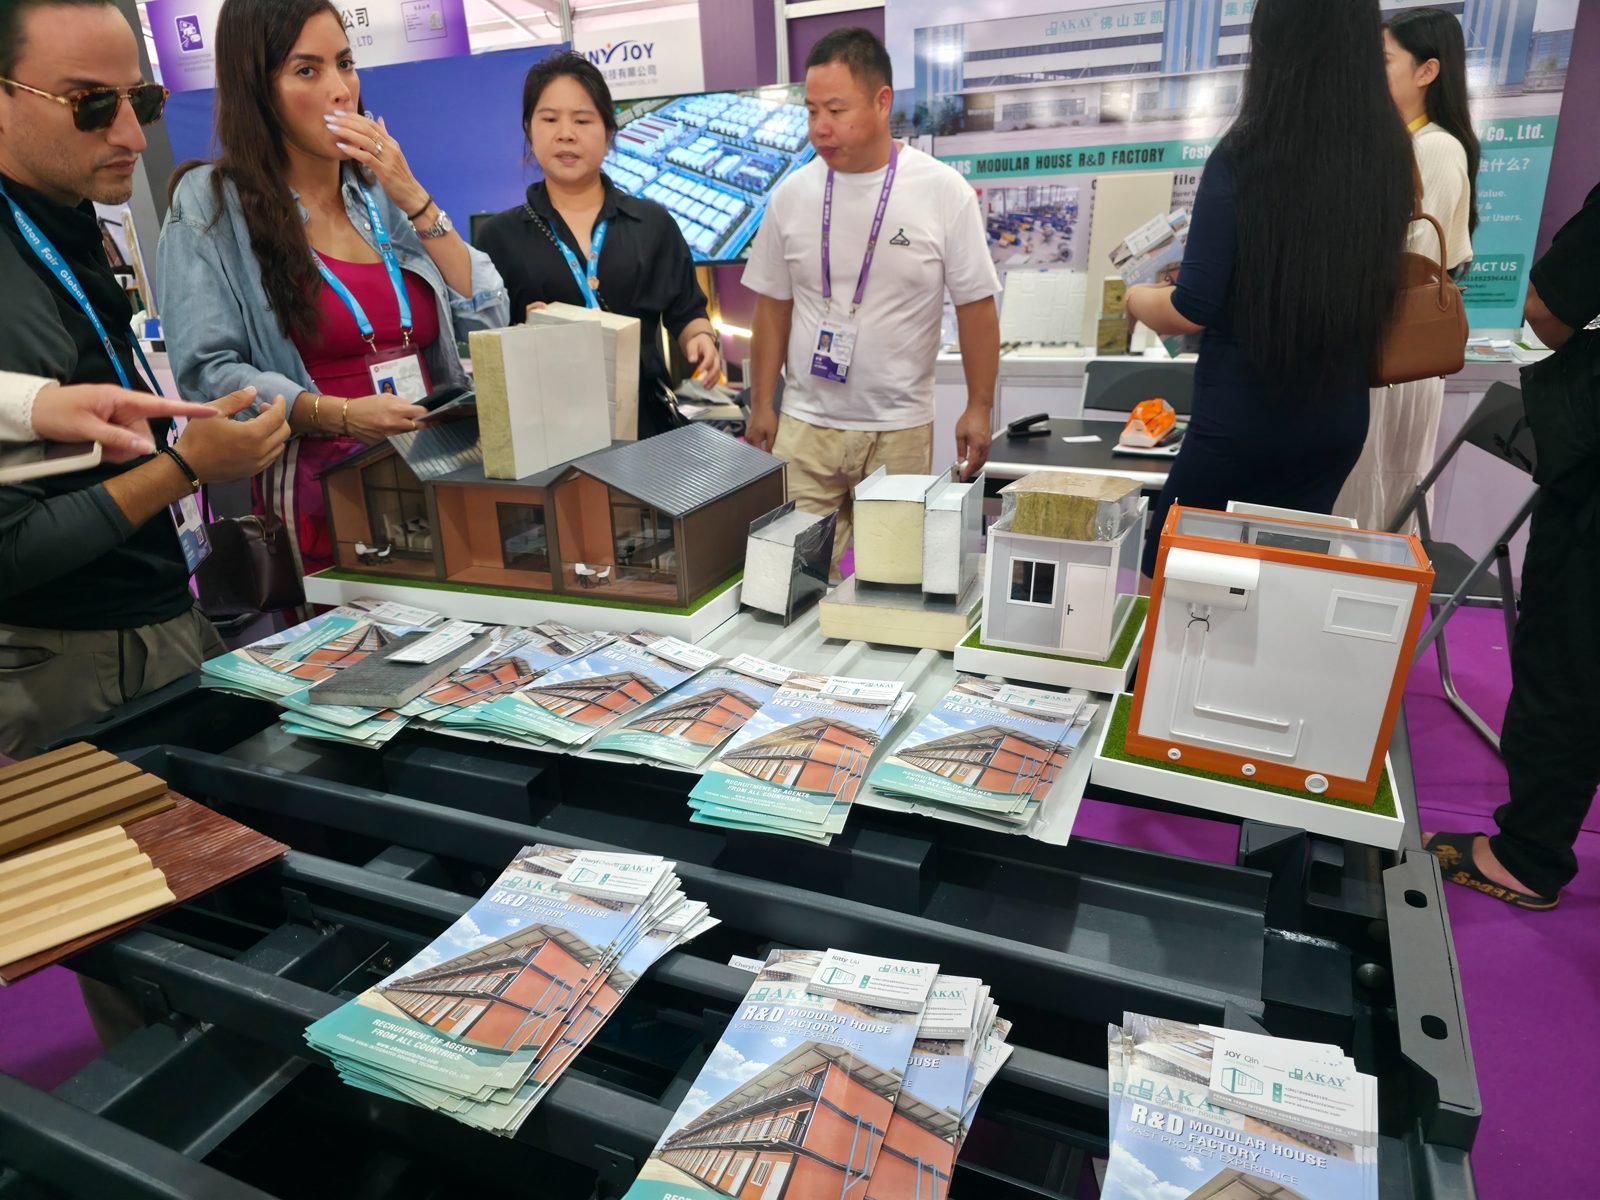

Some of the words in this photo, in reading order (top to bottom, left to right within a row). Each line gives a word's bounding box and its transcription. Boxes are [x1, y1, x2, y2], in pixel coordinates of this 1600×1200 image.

[342, 7, 369, 28] 公司
[622, 42, 654, 62] JOY
[1487, 126, 1513, 142] Co.,
[1517, 123, 1545, 140] Ltd.
[976, 156, 1030, 173] MODULAR
[1036, 153, 1072, 169] HOUSE
[1079, 151, 1105, 167] R&D
[1112, 147, 1165, 165] FACTORY
[15, 210, 41, 245] Canton
[41, 247, 59, 267] Fair
[60, 269, 84, 300] Global
[1500, 261, 1517, 272] US
[944, 701, 975, 714] R&D
[490, 890, 528, 906] R&D
[528, 897, 577, 912] MODULAR
[577, 907, 610, 919] HOUSE
[521, 905, 568, 918] FACTORY
[831, 955, 849, 963] Kitty
[890, 965, 923, 975] AKAY
[929, 989, 962, 998] AKAY
[741, 1004, 786, 1023] R&D
[787, 1008, 848, 1026] MODULAR
[850, 1019, 893, 1035] HOUSE
[783, 1018, 840, 1036] FACTORY
[370, 1028, 397, 1041] FROM
[396, 1036, 412, 1046] ALL
[414, 1041, 462, 1061] COUNTRIES
[371, 1018, 431, 1041] RECRUITMENT
[431, 1036, 445, 1046] OF
[443, 1040, 478, 1056] AGENTS
[803, 1031, 865, 1051] EXPERIENCE
[1223, 1049, 1241, 1059] JOY
[1244, 1055, 1260, 1065] Qin
[1304, 1071, 1346, 1088] AKAY
[1130, 1102, 1185, 1136] R&D
[1189, 1119, 1267, 1151] MODULAR
[1272, 1143, 1328, 1169] HOUSE
[1126, 1124, 1158, 1139] VAST
[1160, 1134, 1216, 1159] PROJECT
[1220, 1154, 1299, 1185] EXPERIENCE
[1188, 1133, 1261, 1162] FACTORY
